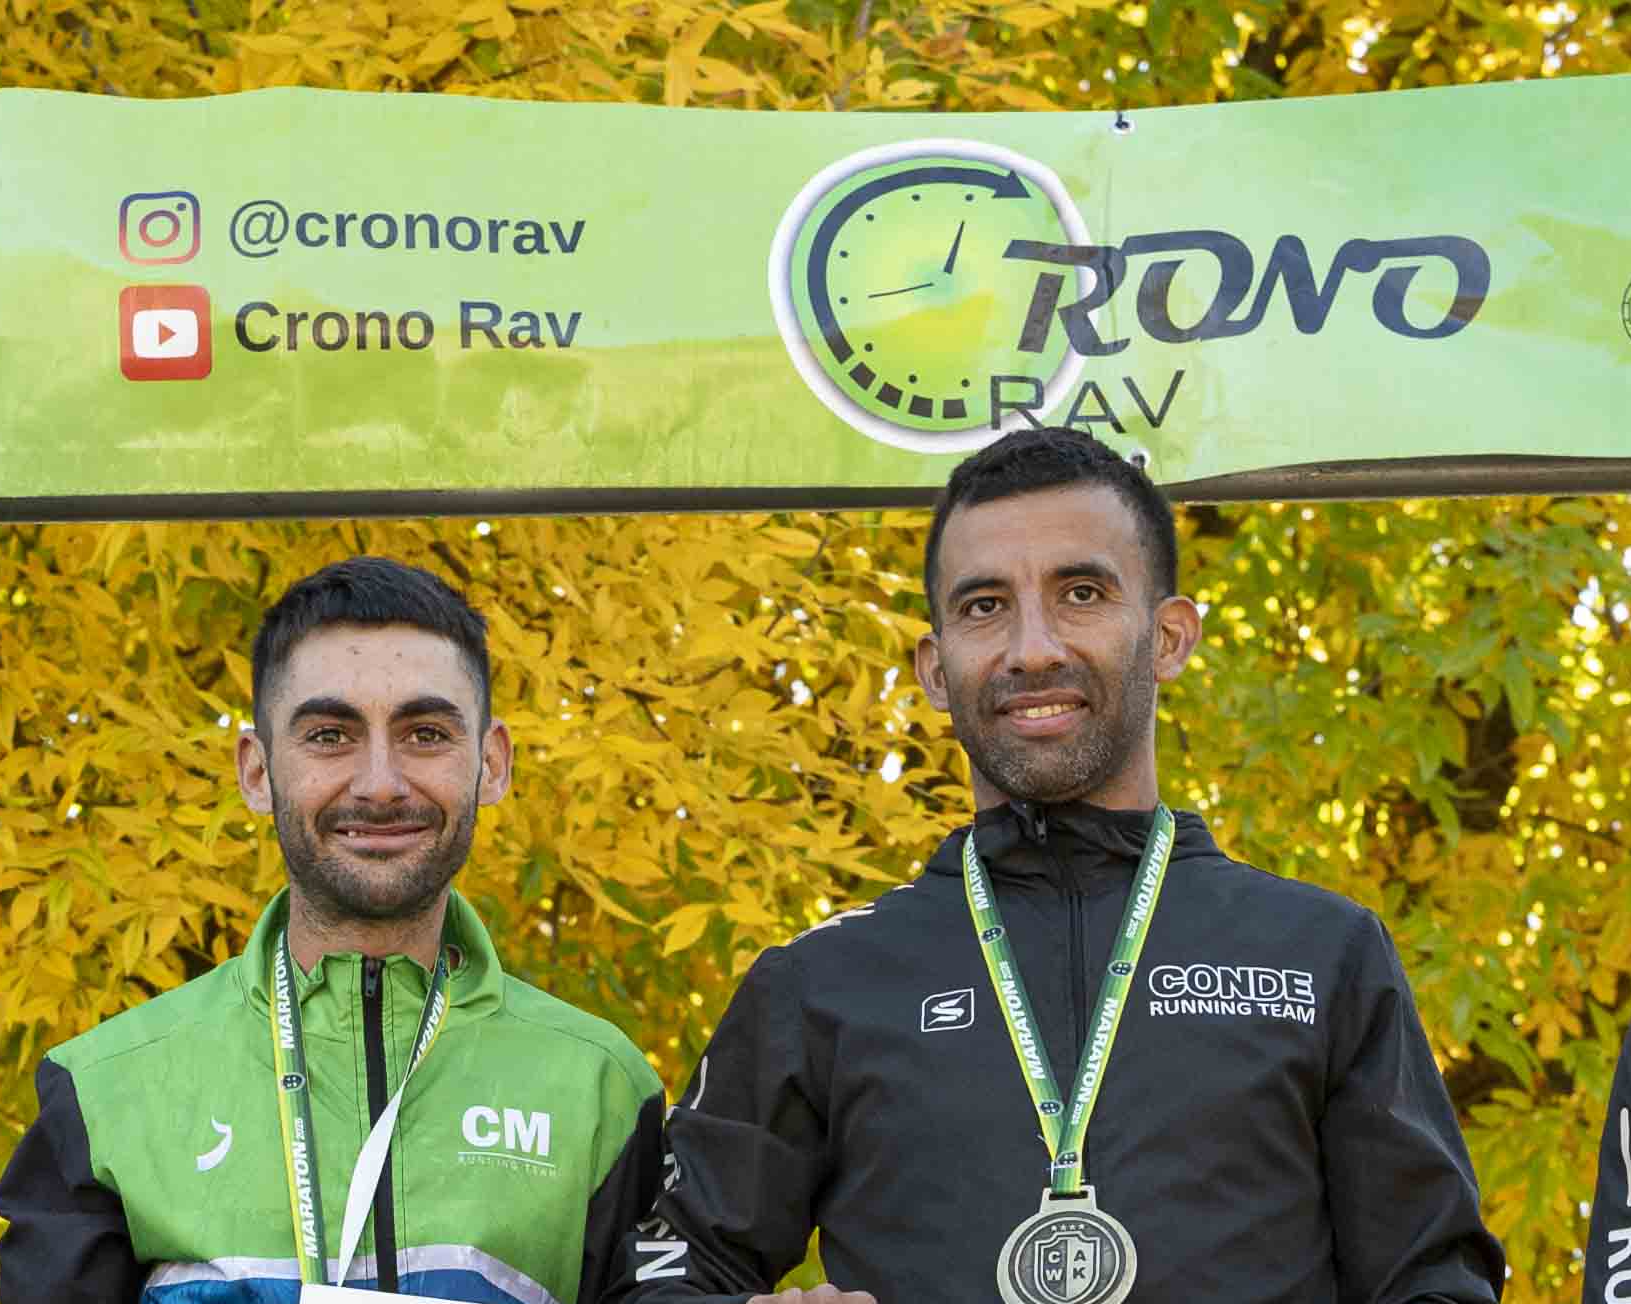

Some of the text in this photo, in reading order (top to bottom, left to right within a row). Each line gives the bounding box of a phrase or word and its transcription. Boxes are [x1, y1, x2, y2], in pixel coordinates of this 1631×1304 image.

[229, 198, 586, 260] @cronorav
[235, 298, 583, 353] Crono Rav
[991, 370, 1185, 436] RAV
[1134, 830, 1169, 922] MARATON
[1148, 964, 1316, 1004] CONDE
[1149, 999, 1316, 1025] RUNNING TEAM
[999, 979, 1046, 1081] MARATON
[1076, 996, 1120, 1104] MARATON
[460, 1104, 552, 1157] CM
[292, 1140, 320, 1259] MARATON
